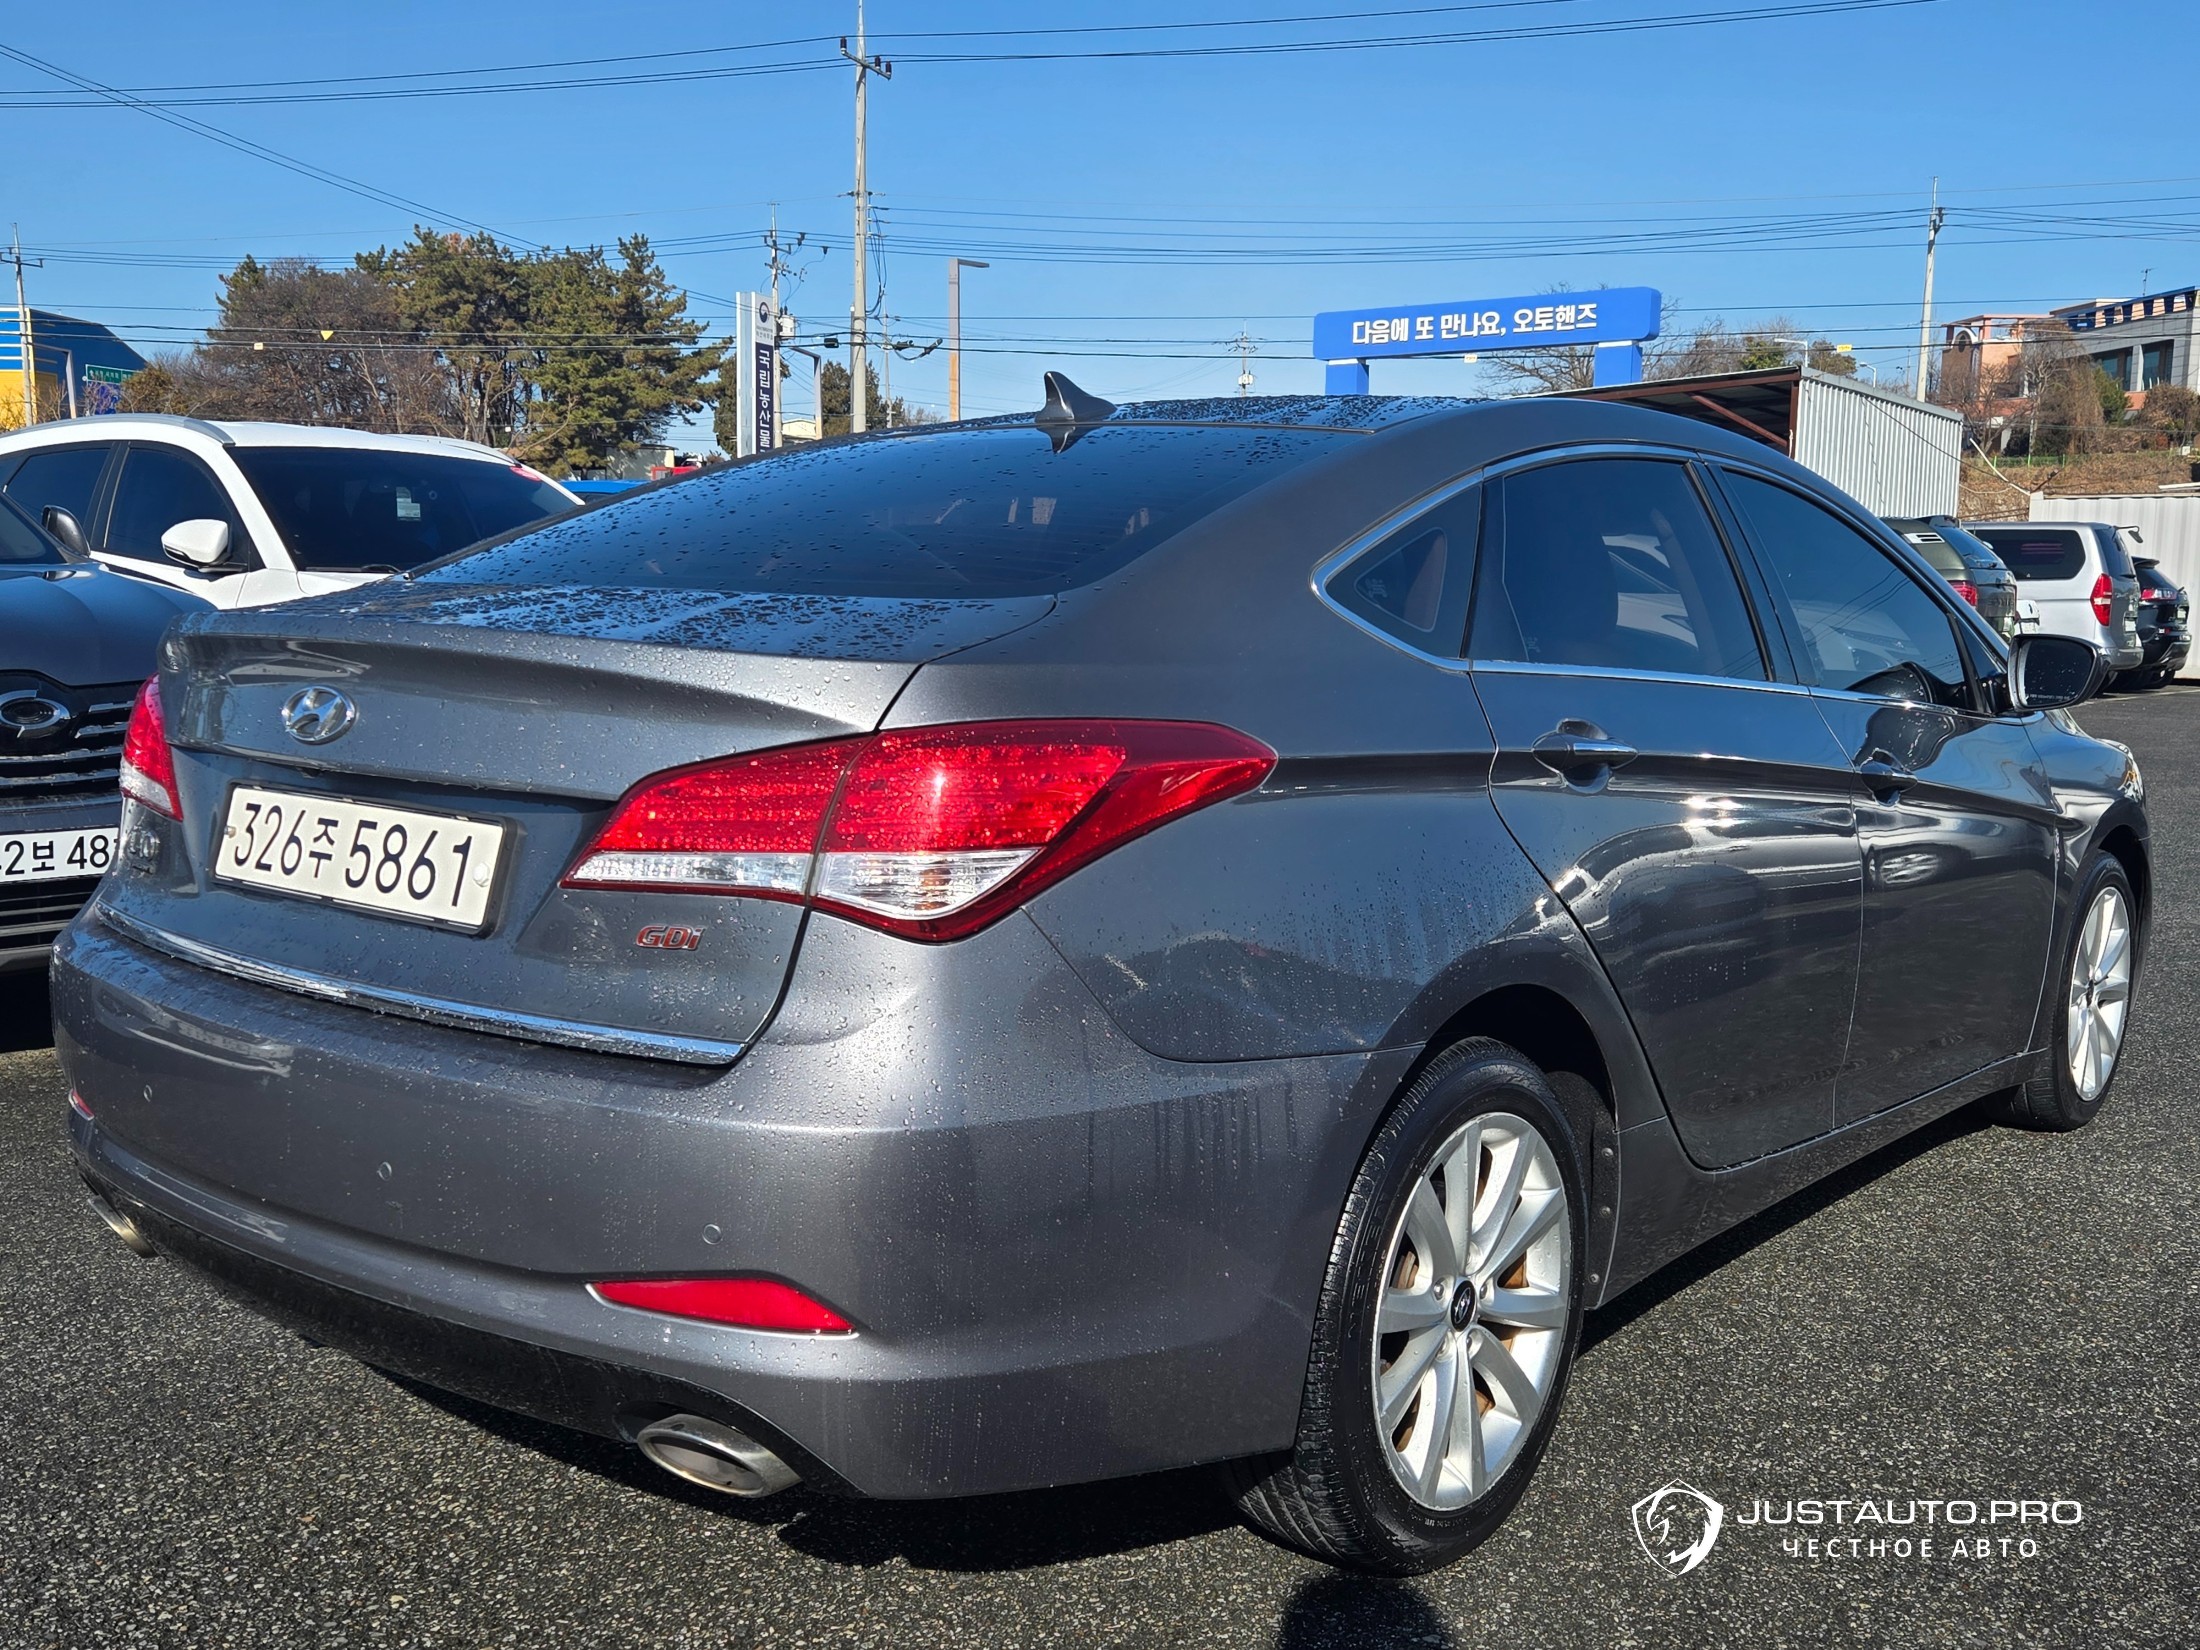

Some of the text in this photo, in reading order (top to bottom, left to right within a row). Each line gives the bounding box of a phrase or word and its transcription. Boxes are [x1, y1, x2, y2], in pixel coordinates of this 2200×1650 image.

[1352, 317, 1409, 345] 다음에
[1415, 316, 1434, 341] 또
[1441, 311, 1507, 338] 만나요,
[759, 349, 771, 453] 국립농산물
[0, 834, 120, 877] 2보 48
